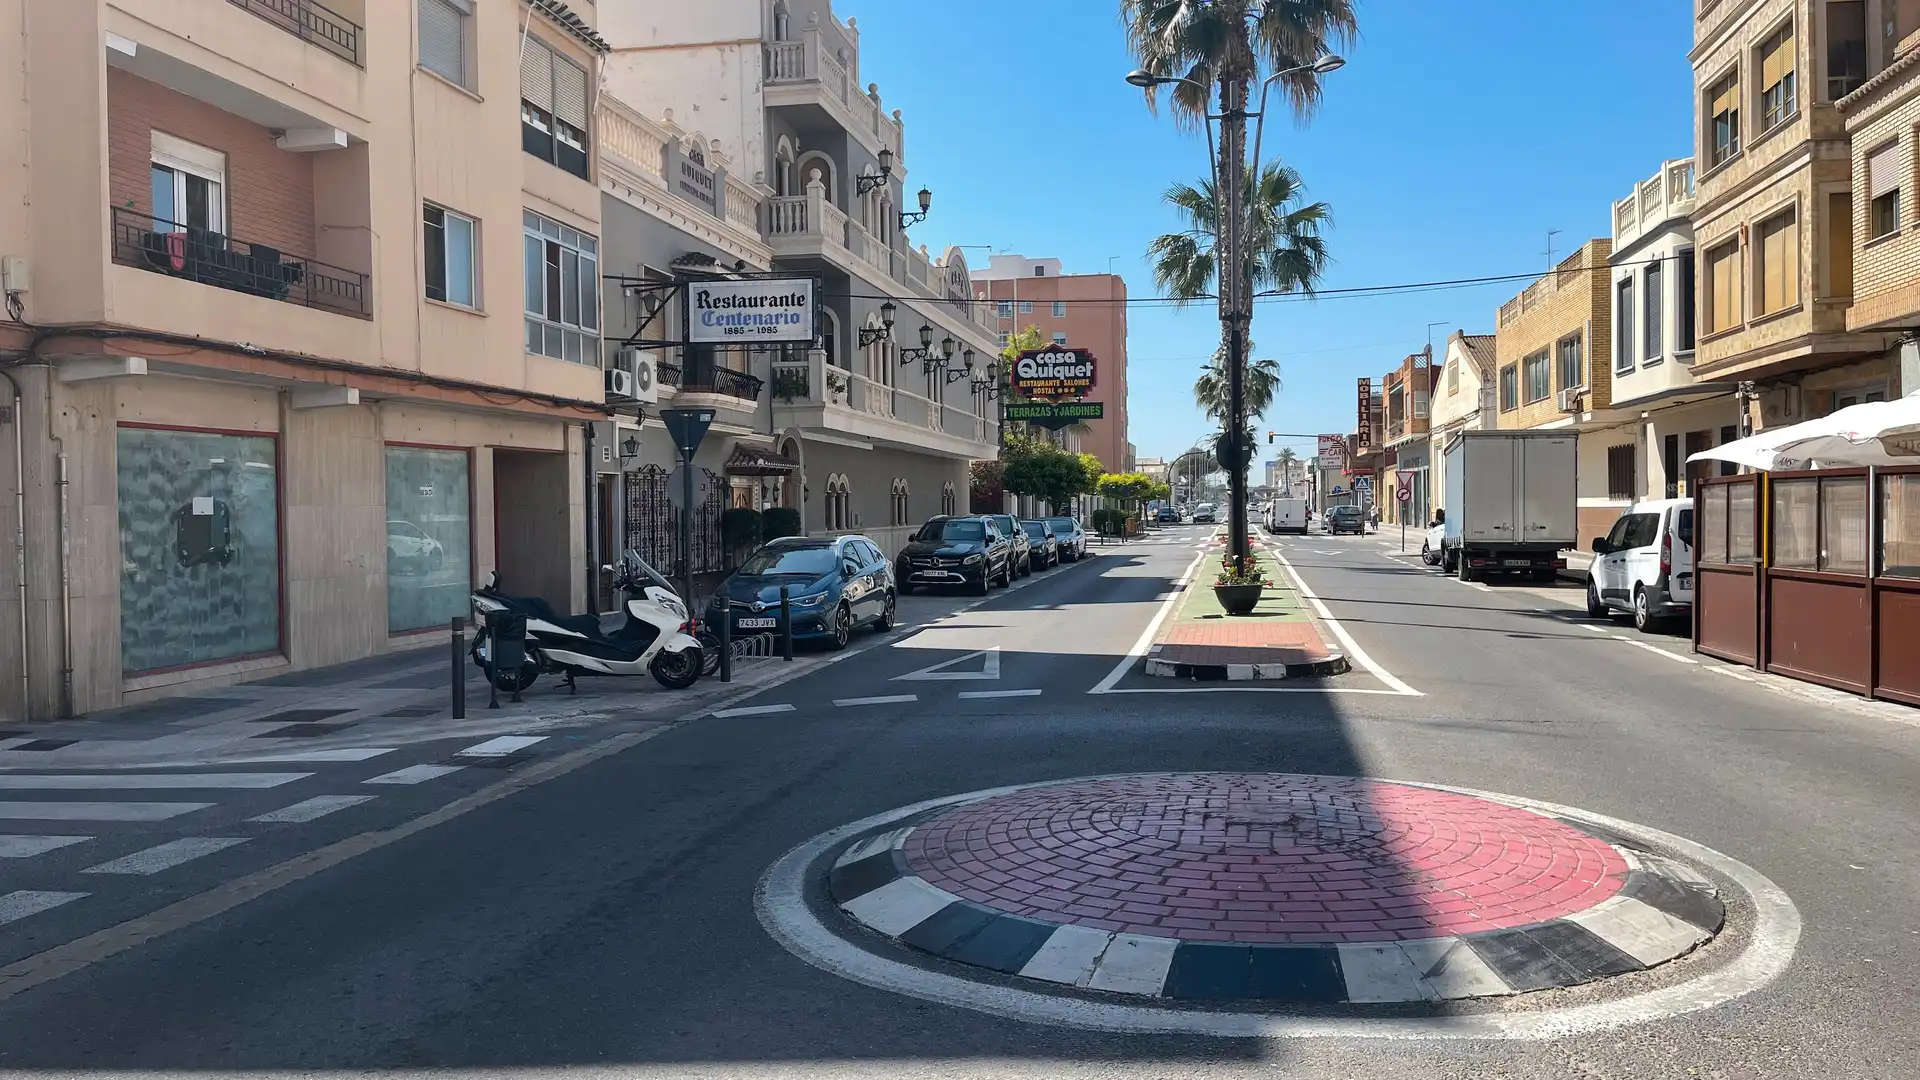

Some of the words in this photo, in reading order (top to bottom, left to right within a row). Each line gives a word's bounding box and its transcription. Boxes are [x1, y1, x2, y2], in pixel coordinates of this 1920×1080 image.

[696, 289, 806, 309] Restaurante
[701, 308, 801, 327] Centenario
[724, 327, 745, 335] 1885
[757, 326, 778, 334] 1985
[1036, 351, 1076, 364] casa
[1017, 358, 1093, 380] Quiquet
[1019, 379, 1060, 388] RESTAURANTE
[1063, 379, 1090, 387] SALONES
[1032, 387, 1055, 395] HOSTAL
[1008, 406, 1051, 418] TERRAZAS
[1059, 405, 1101, 417] JARDINES
[1358, 378, 1370, 447] MOBILIARIO
[1328, 448, 1342, 456] CAR
[740, 619, 759, 627] 7433
[760, 619, 775, 627] JVX
